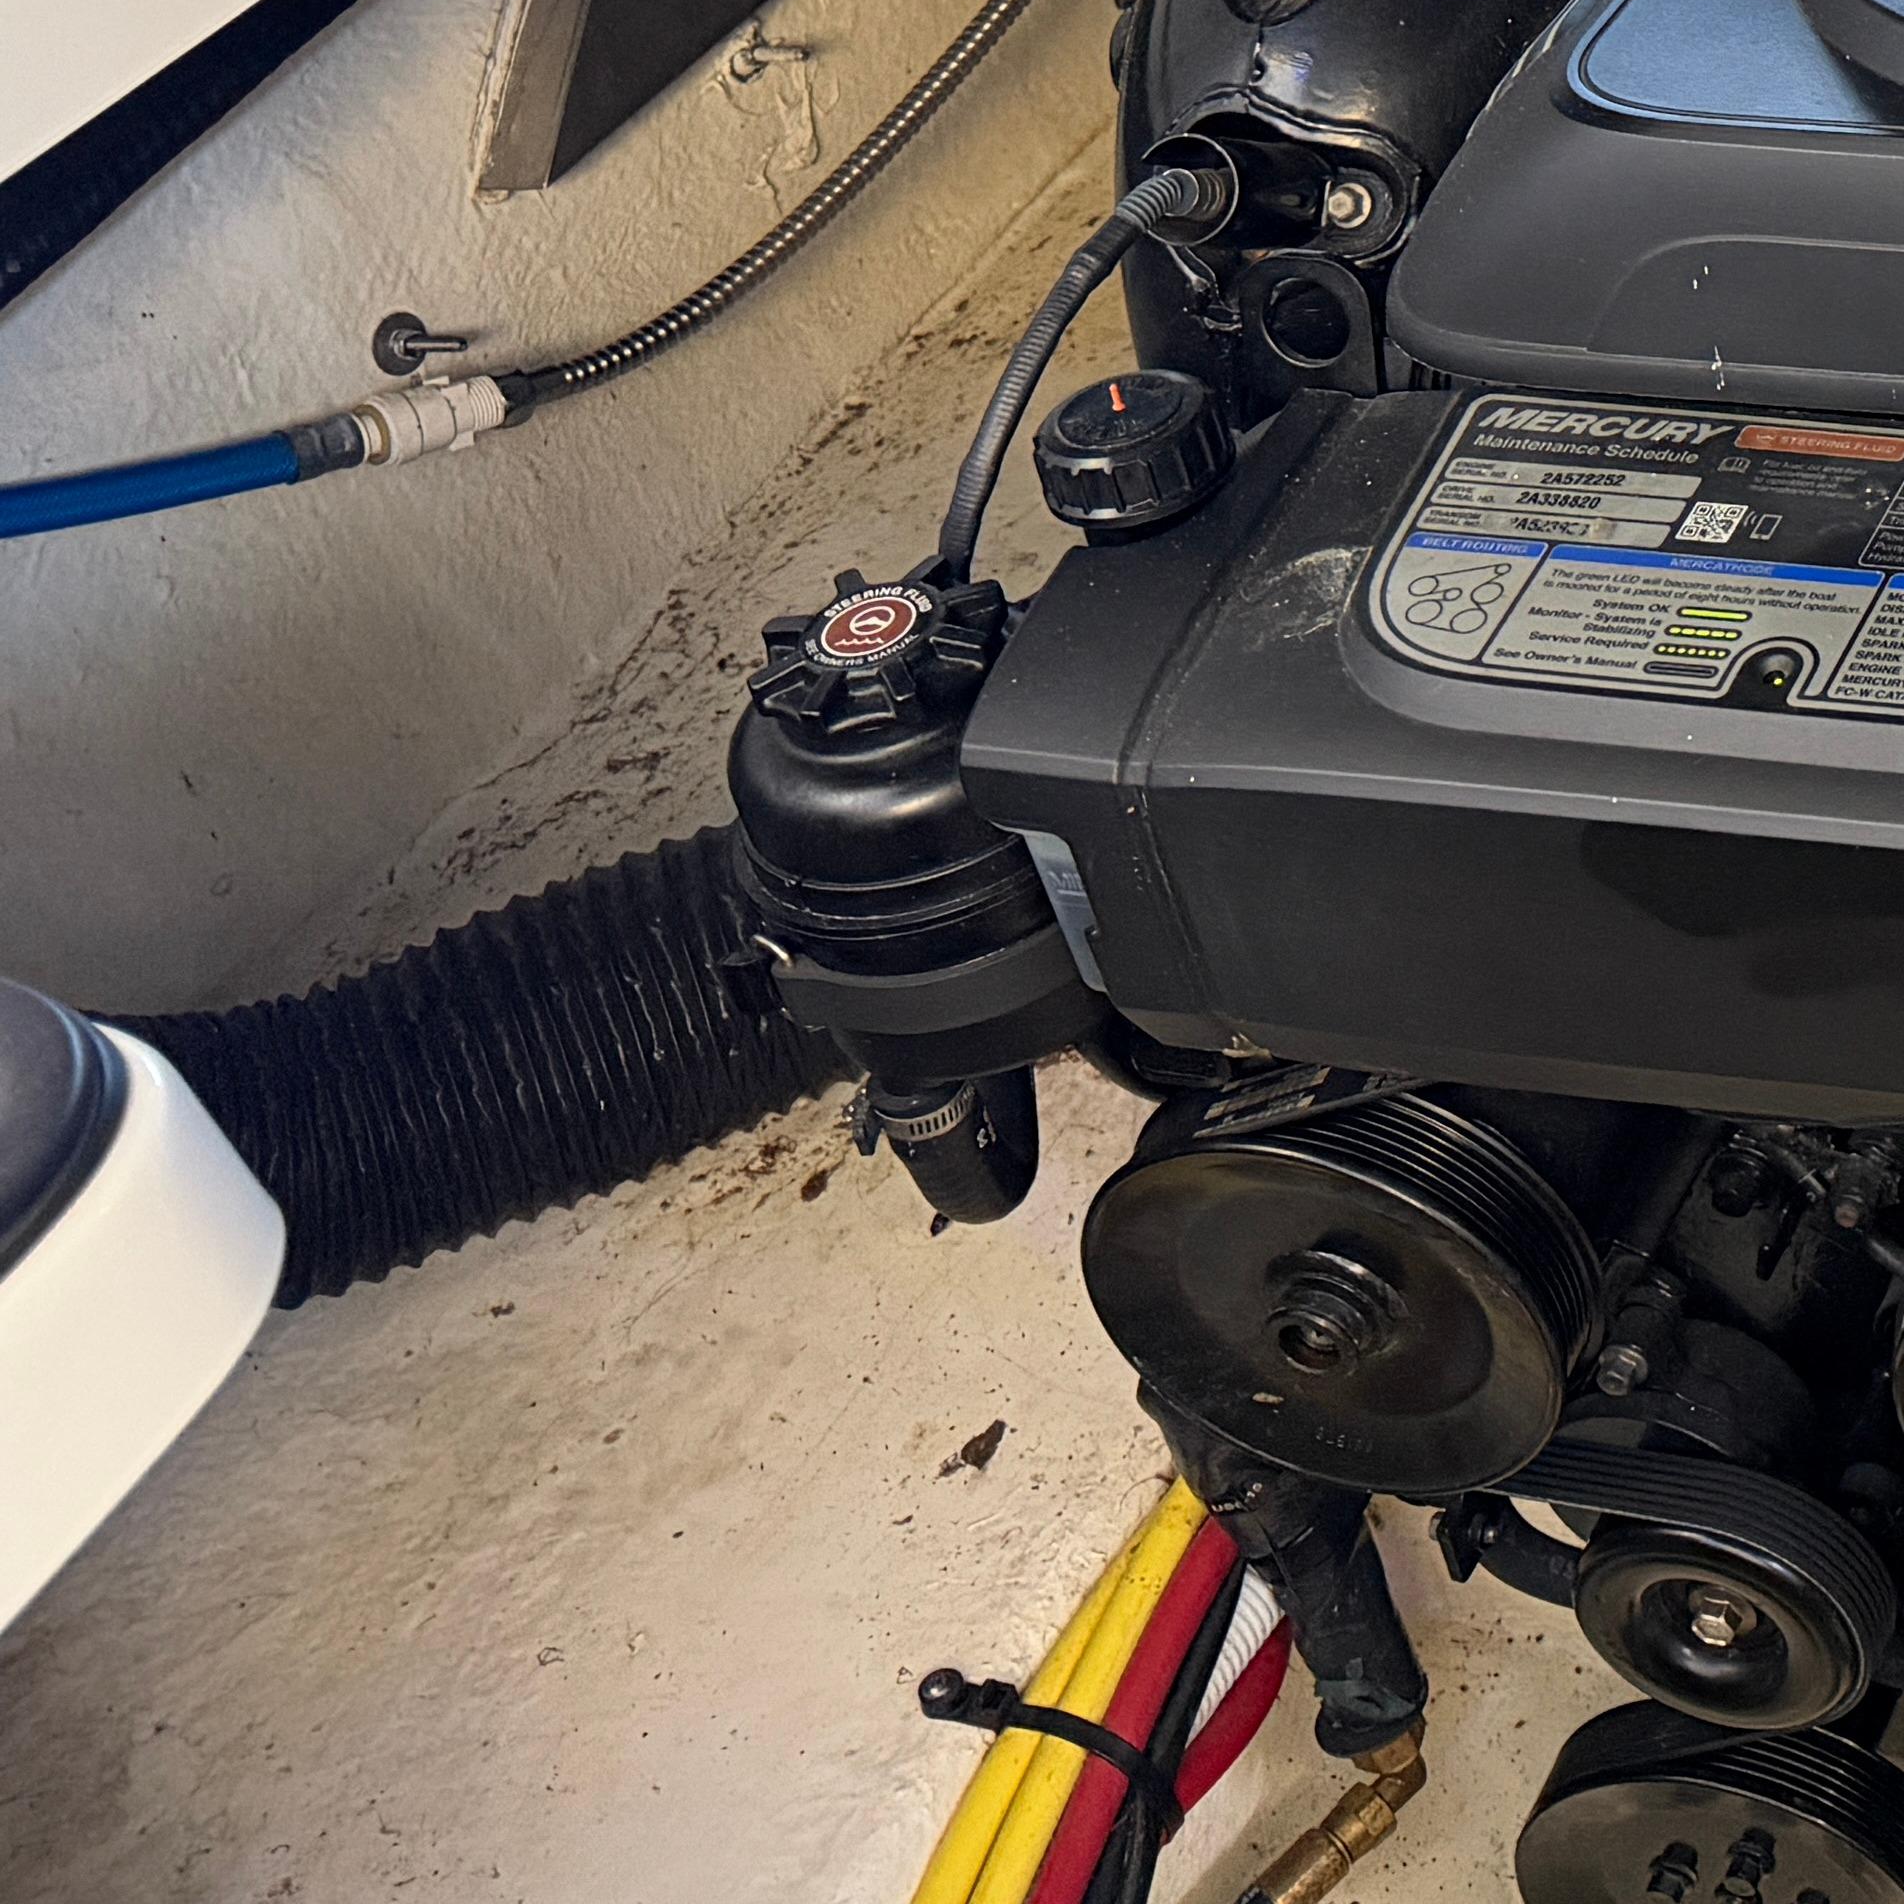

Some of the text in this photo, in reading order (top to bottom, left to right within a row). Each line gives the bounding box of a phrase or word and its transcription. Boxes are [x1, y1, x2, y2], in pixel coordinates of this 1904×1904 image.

[1476, 406, 1737, 445] MERCURY
[1471, 433, 1702, 464] Maintenance Schedule
[1778, 435, 1898, 453] STEERING FLUID
[1539, 469, 1627, 488] 2A572252
[1515, 491, 1602, 509] 2A338820
[1550, 569, 1575, 578] The
[1611, 573, 1641, 583] LED
[824, 586, 904, 618] STEERING
[1591, 598, 1672, 613] System OK
[1527, 606, 1584, 618] Monitor
[1592, 612, 1648, 625] System
[1649, 617, 1663, 625] is
[1580, 623, 1658, 638] Stabilizing
[1866, 627, 1901, 637] IDLE
[1526, 630, 1650, 651] Service Required
[1492, 648, 1638, 668] See Owner's Manual
[1853, 650, 1904, 662] SPARK
[1847, 662, 1902, 674] ENGINE
[1833, 686, 1873, 697] FC-W
